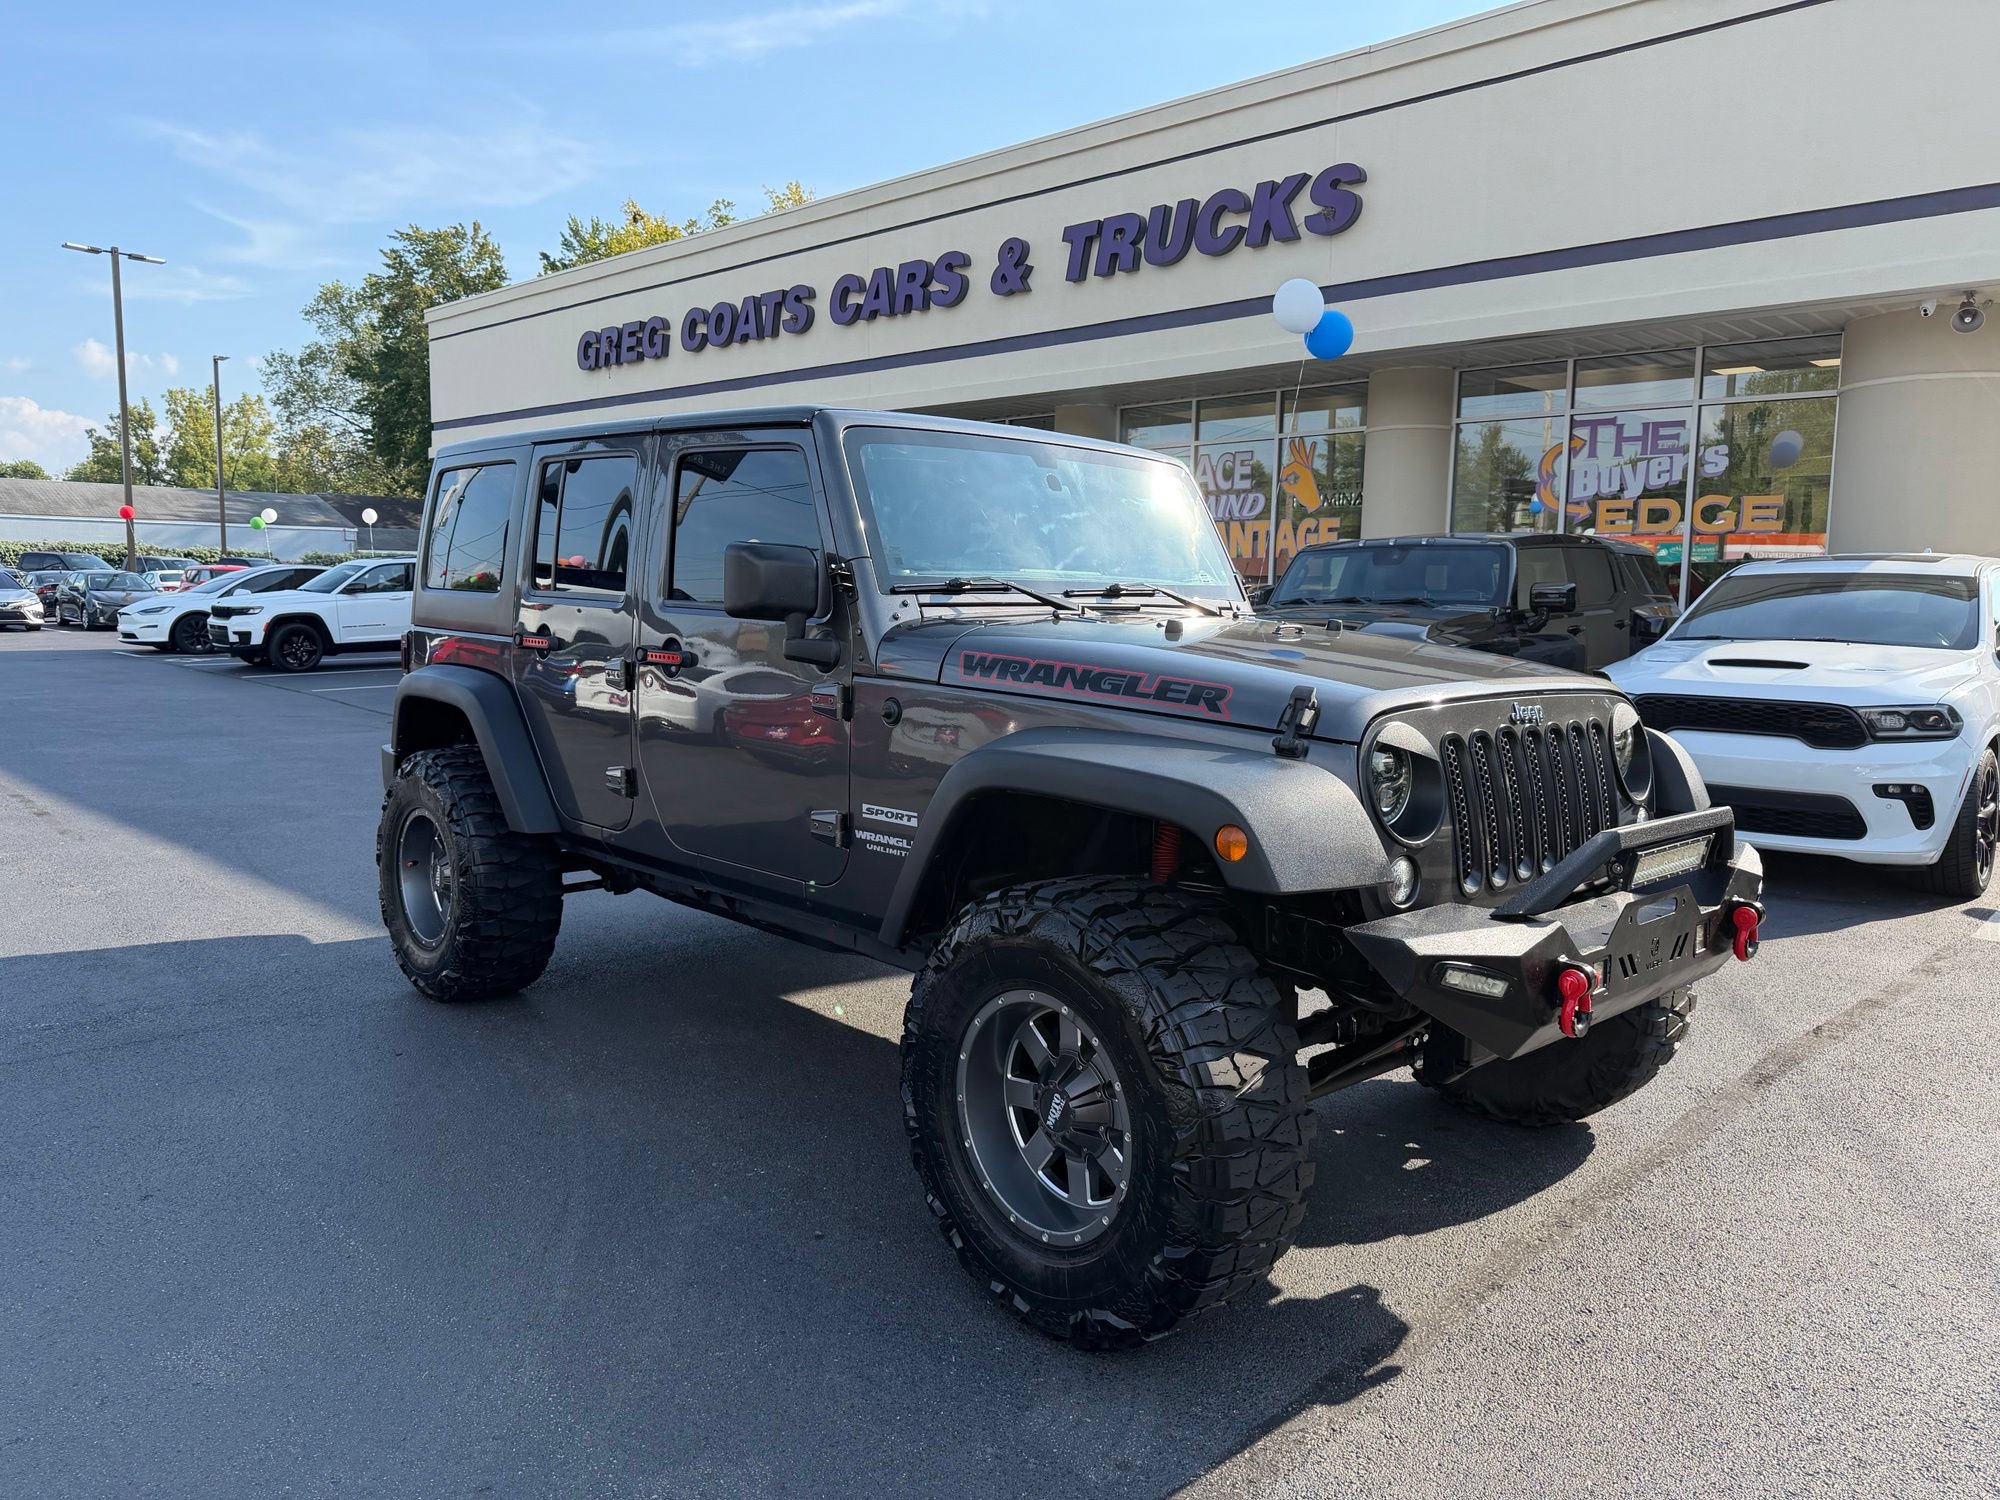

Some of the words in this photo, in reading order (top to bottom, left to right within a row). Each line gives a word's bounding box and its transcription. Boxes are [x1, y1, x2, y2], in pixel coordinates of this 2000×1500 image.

[577, 316, 671, 371] GREG
[681, 284, 816, 352] COATS
[829, 250, 971, 326] CARS
[990, 237, 1034, 296] &
[1062, 162, 1367, 283] TRUCKS
[1572, 416, 1686, 459] THE
[1594, 494, 1784, 535] EDGE
[961, 651, 1233, 718] WRANGLER
[1510, 701, 1543, 726] Jeep
[863, 807, 918, 823] SPORT
[855, 829, 913, 849] WRANGL
[866, 843, 909, 857] UNLIMIT
